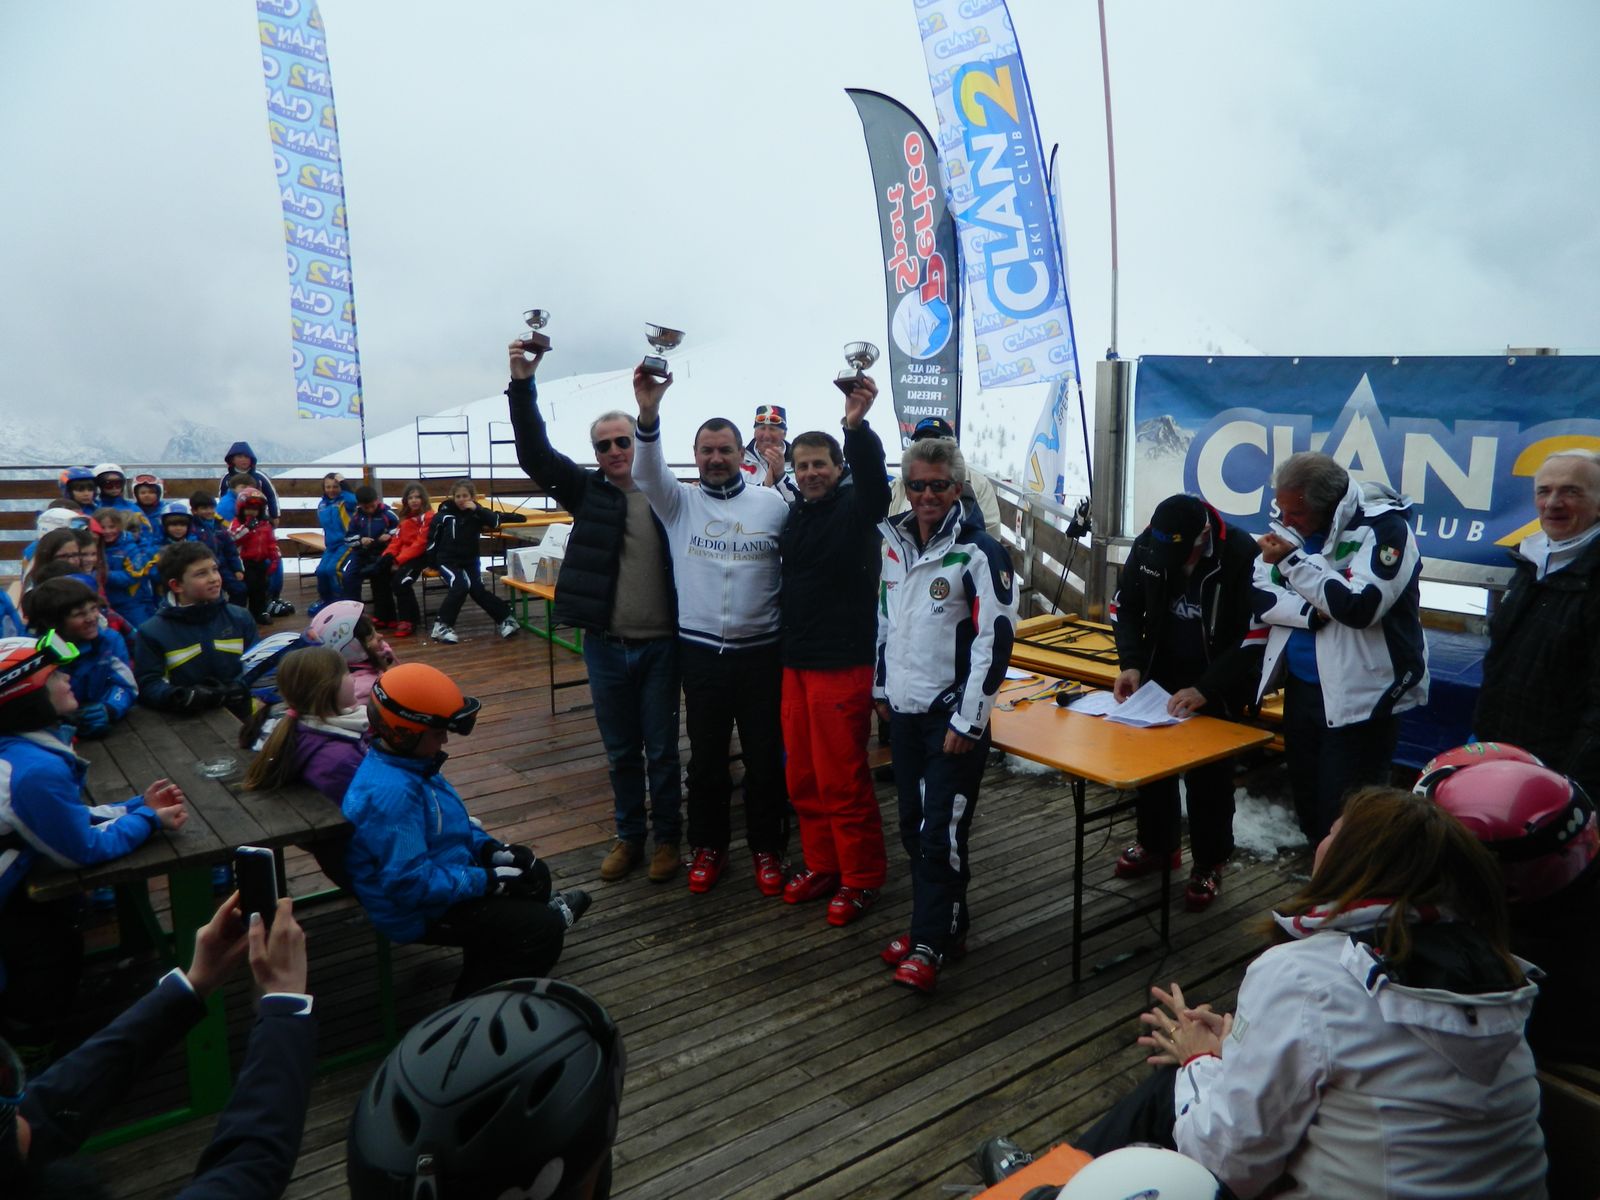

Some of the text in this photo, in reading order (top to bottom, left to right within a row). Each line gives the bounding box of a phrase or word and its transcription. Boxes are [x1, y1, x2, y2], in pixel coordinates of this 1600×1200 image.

[1012, 131, 1031, 185] CLUB
[961, 65, 1051, 313] CLAN2
[1028, 223, 1044, 256] SKI
[1416, 513, 1486, 542] LUB
[0, 654, 45, 686] COTT
